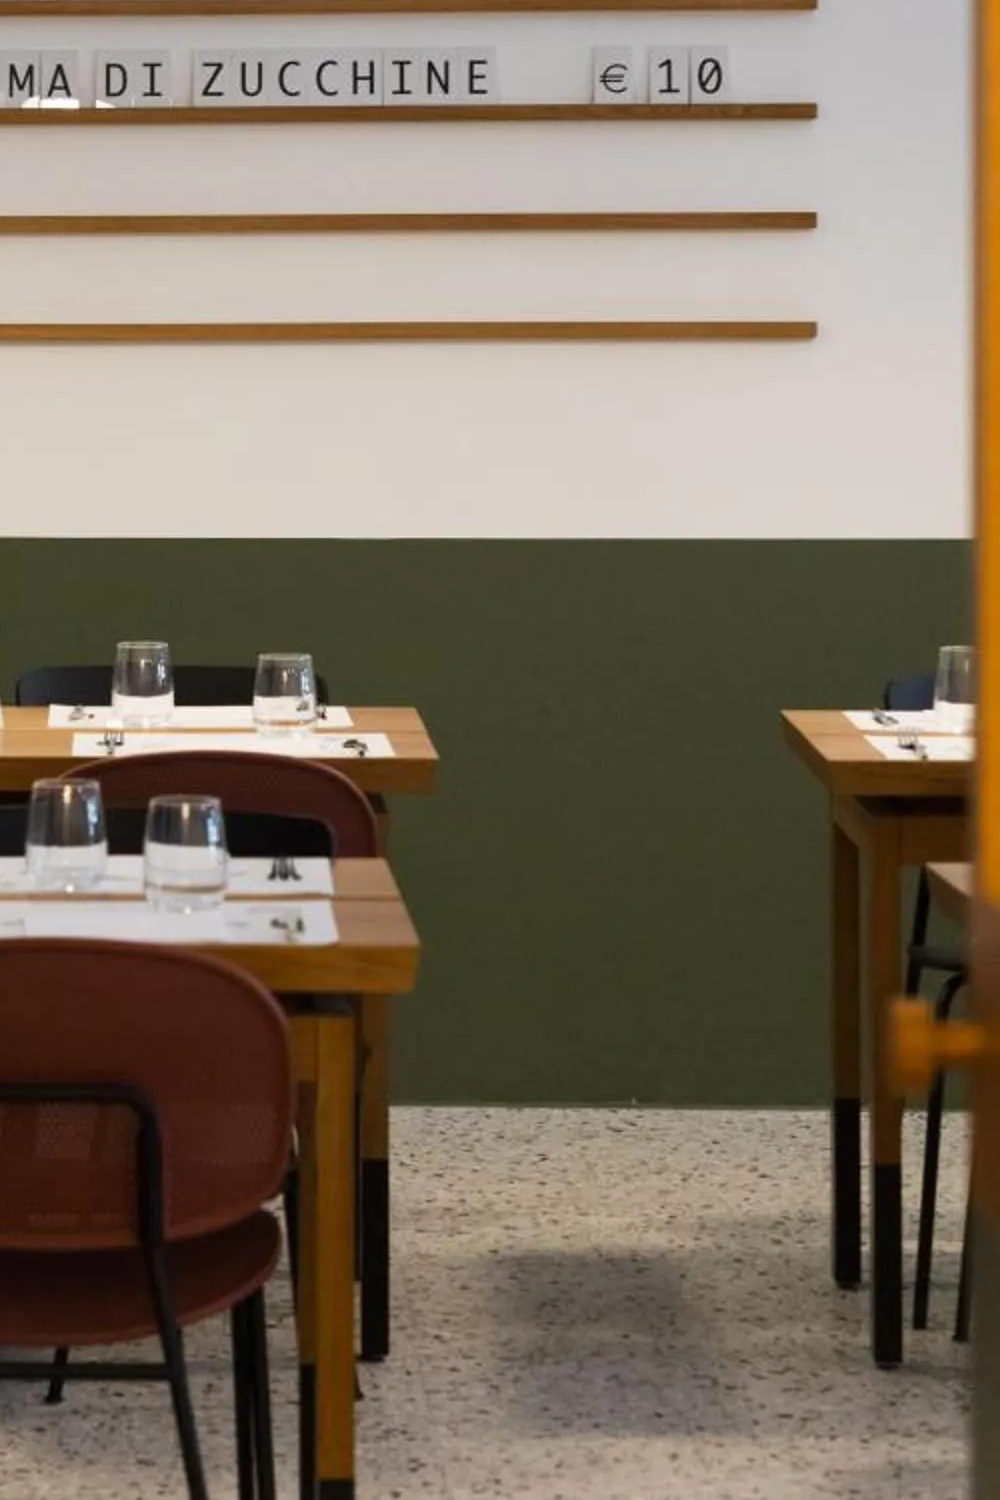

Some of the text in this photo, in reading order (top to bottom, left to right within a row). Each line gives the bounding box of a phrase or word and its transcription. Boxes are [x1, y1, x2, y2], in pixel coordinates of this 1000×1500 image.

[105, 62, 163, 97] DI
[201, 59, 488, 97] ZUCCHINE
[599, 63, 629, 94] €
[658, 57, 723, 95] 10
